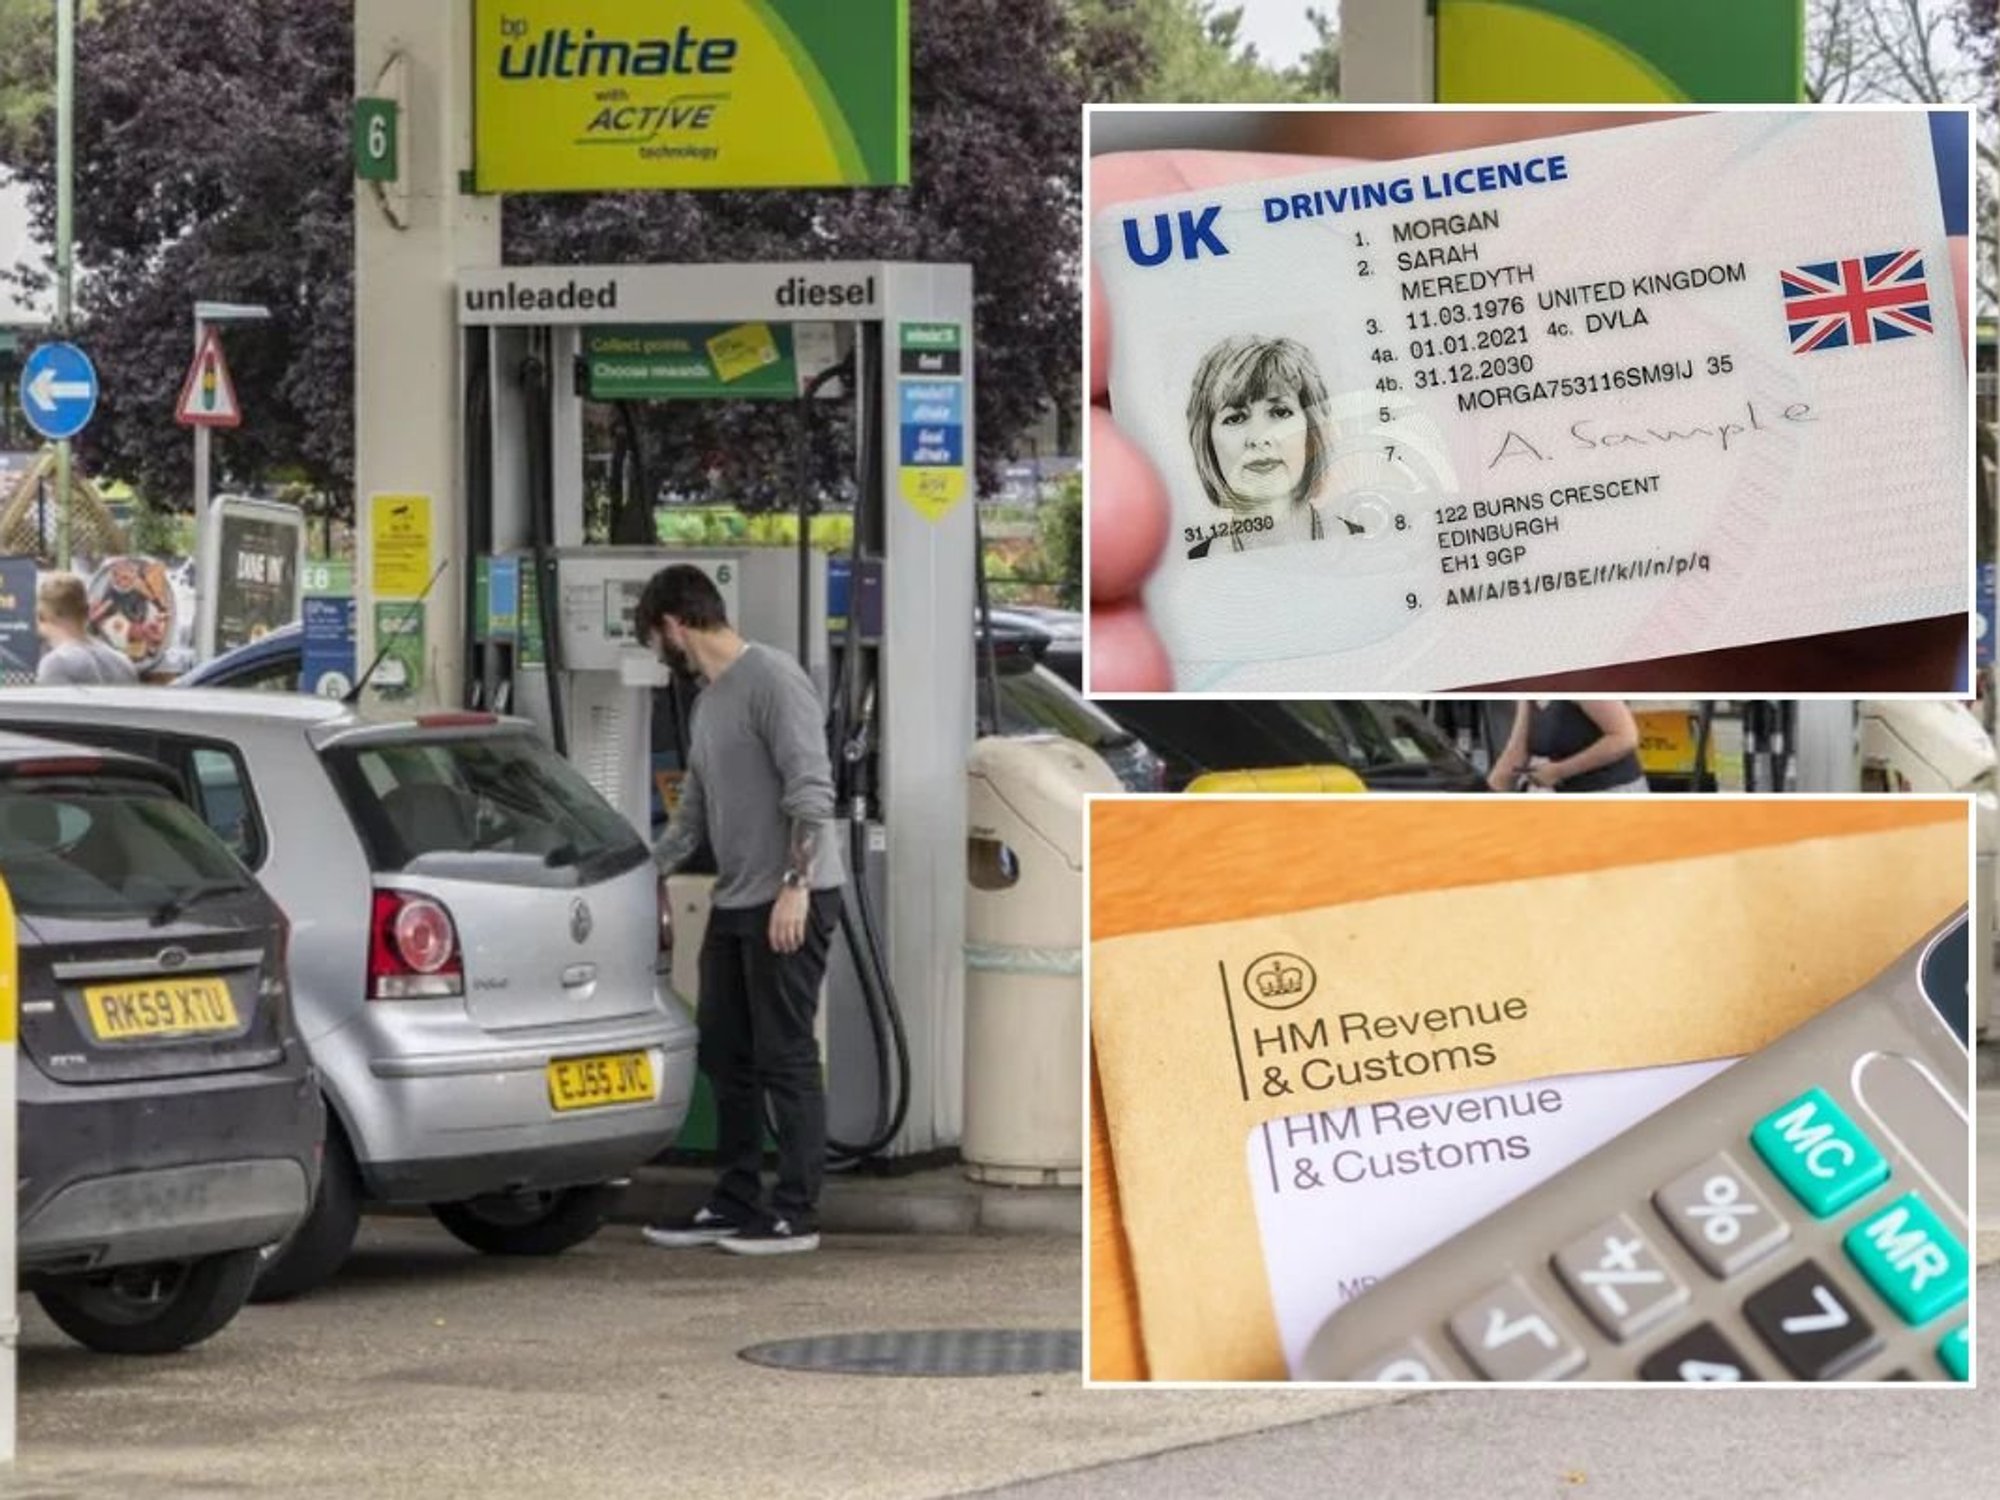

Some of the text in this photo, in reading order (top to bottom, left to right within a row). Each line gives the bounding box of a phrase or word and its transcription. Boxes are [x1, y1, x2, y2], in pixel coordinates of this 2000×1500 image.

[500, 14, 527, 40] bp
[498, 25, 738, 79] ultimate
[595, 88, 630, 102] with
[367, 115, 387, 159] 6
[587, 103, 717, 132] ACTIVE
[639, 145, 719, 160] technology
[1264, 154, 1569, 223] DRIVING LICENCE
[1122, 205, 1230, 268] UK
[1354, 209, 1500, 248] 1. MORGAN
[1357, 242, 1479, 277] 2. SARAH
[465, 277, 875, 312] unleaded diesel
[1366, 262, 1747, 336] 3. 11.03.1976 UNITED KINGDOM
[1401, 263, 1535, 302] MEREDYTH
[592, 338, 641, 353] Collect
[1371, 307, 1649, 365] 4a. 01.01.2021 4c. DVLA
[593, 362, 648, 378] Choose
[1375, 353, 1534, 393] 4b. 31.12.2030
[1378, 406, 1396, 423] 5.
[1706, 354, 1734, 376] 35
[1384, 445, 1403, 462] 7.
[1488, 401, 1820, 469] A. Sample
[1394, 475, 1661, 532] 8. 122 BURNS CRESCENT
[1184, 514, 1275, 542] 31.12.2030
[1438, 515, 1560, 550] EDINBURGH
[716, 564, 732, 584] 6
[1441, 545, 1527, 574] EH1 9GP
[1405, 592, 1423, 610] 9.
[101, 986, 227, 1031] RK59 XTU
[1254, 996, 1529, 1058] HM Revenue
[557, 1061, 613, 1100] EJ55
[1262, 1040, 1498, 1098] & Customs
[1284, 1086, 1564, 1148] HM Revenue
[1773, 1099, 1855, 1179] MC
[1293, 1133, 1531, 1191] & Customs
[1865, 1206, 1949, 1293] MR
[1781, 1284, 1851, 1334] 7
